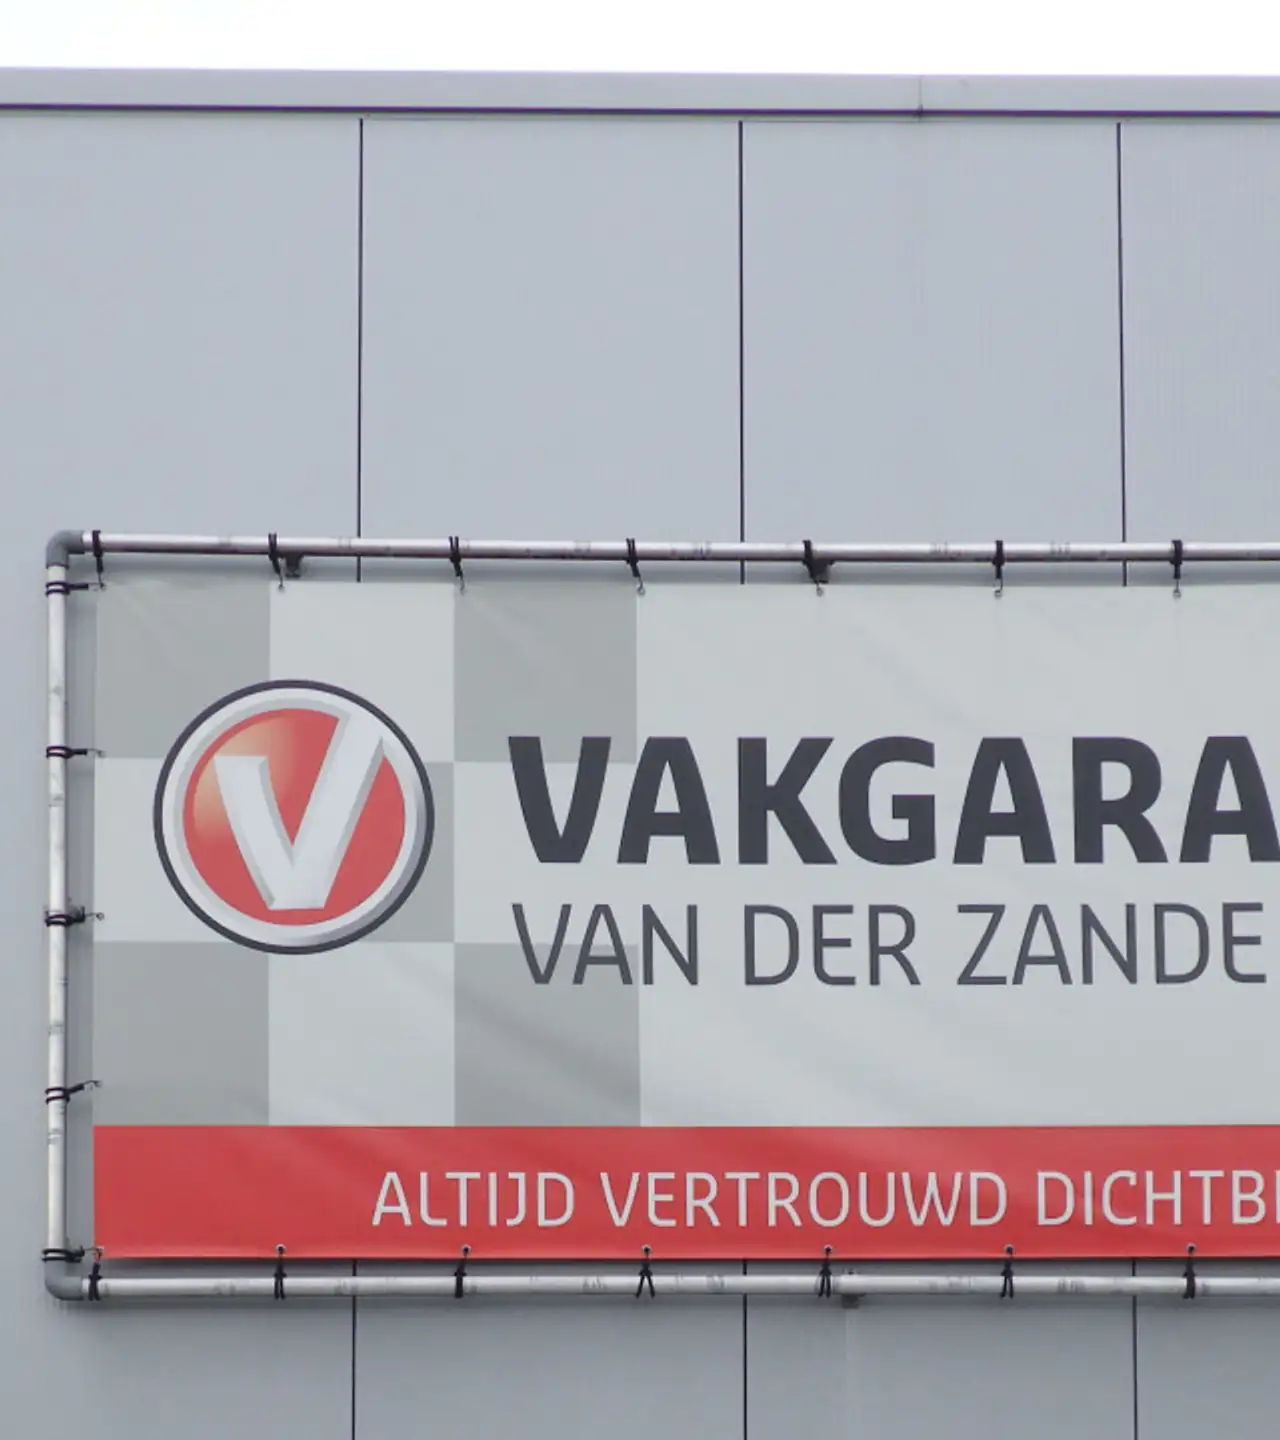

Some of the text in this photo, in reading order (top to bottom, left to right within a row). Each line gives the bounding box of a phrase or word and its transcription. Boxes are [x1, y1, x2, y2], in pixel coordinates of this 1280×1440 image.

[213, 708, 385, 910] V
[511, 902, 1267, 986] VAN DER ZANDE
[371, 1171, 575, 1227] ALTIJD
[600, 1171, 1008, 1227] VERTROUWD
